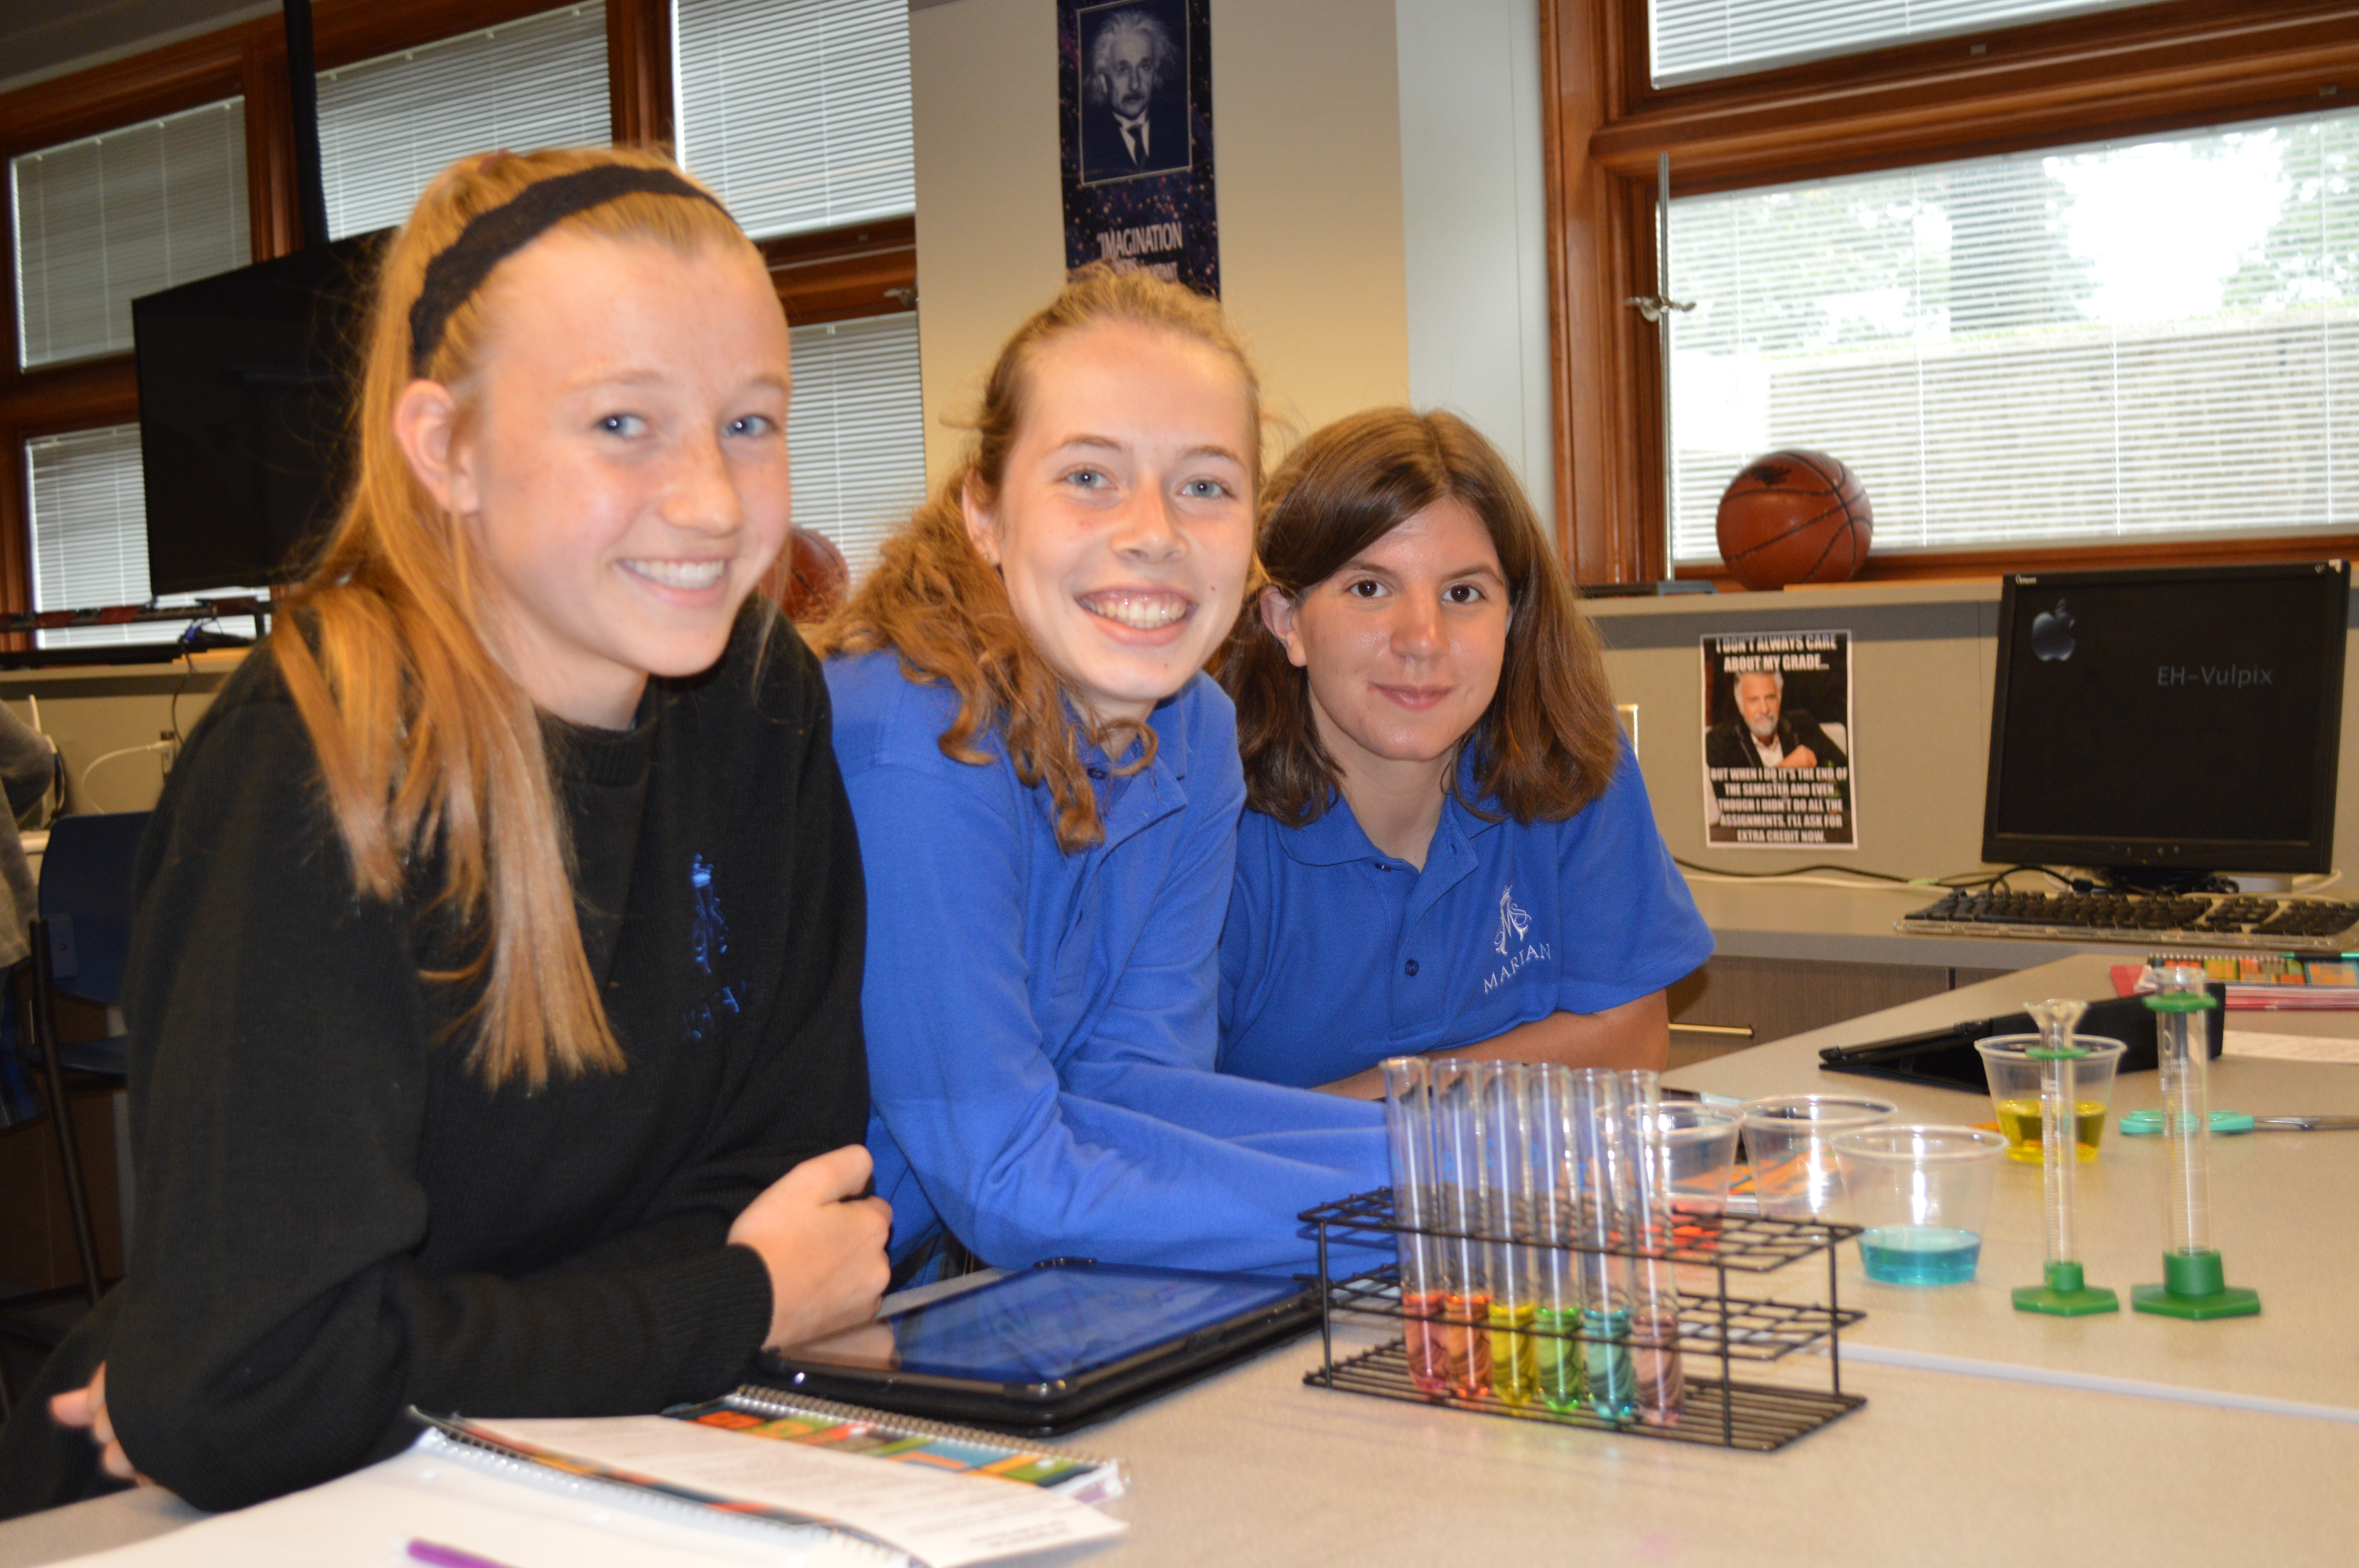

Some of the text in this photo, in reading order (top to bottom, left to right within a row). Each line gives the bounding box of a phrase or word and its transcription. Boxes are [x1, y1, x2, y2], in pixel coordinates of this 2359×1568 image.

[1716, 632, 1837, 653] I DON'T ALWAYS CARE
[1724, 655, 1761, 672] ABOUT
[1763, 654, 1781, 671] MY
[2158, 664, 2273, 689] EH-Vulpix
[1710, 766, 1847, 782] BUT WHEN I DO IT'S THE END OF
[1724, 782, 1834, 797] THE SEMESTER AND EVEN
[1718, 798, 1843, 813] THOUGH I DIDN'T DO ALL THE
[1787, 814, 1803, 828] I'LL
[1804, 814, 1823, 828] ASK
[1824, 814, 1843, 829] FOR
[1737, 829, 1765, 842] EXTRA
[1766, 829, 1799, 842] CREDIT
[1484, 943, 1551, 995] MARIAN
